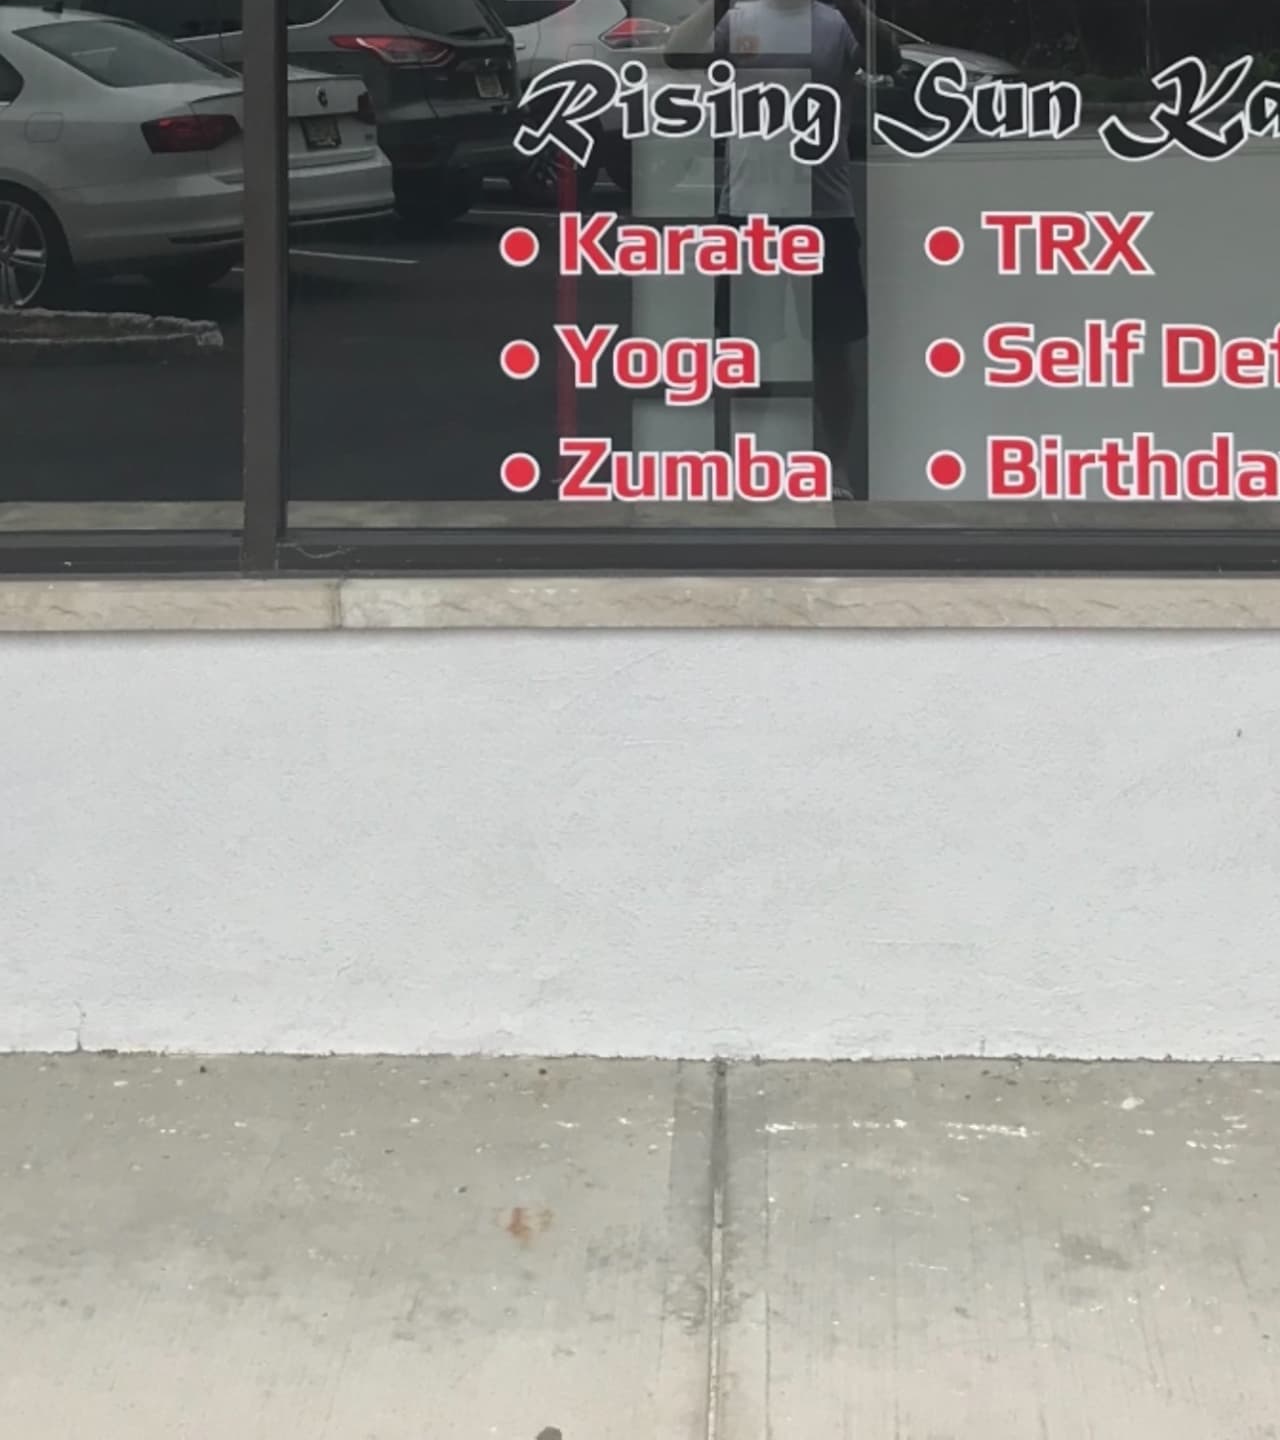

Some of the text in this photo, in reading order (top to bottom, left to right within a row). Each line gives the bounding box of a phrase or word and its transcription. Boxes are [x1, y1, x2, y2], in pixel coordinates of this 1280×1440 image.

[513, 59, 841, 167] Rising
[872, 56, 1082, 157] Sun
[557, 210, 826, 276] Karate
[982, 210, 1155, 277] TRX
[554, 323, 761, 407] Yoga
[983, 317, 1145, 390] Self
[557, 433, 832, 503] Zumba
